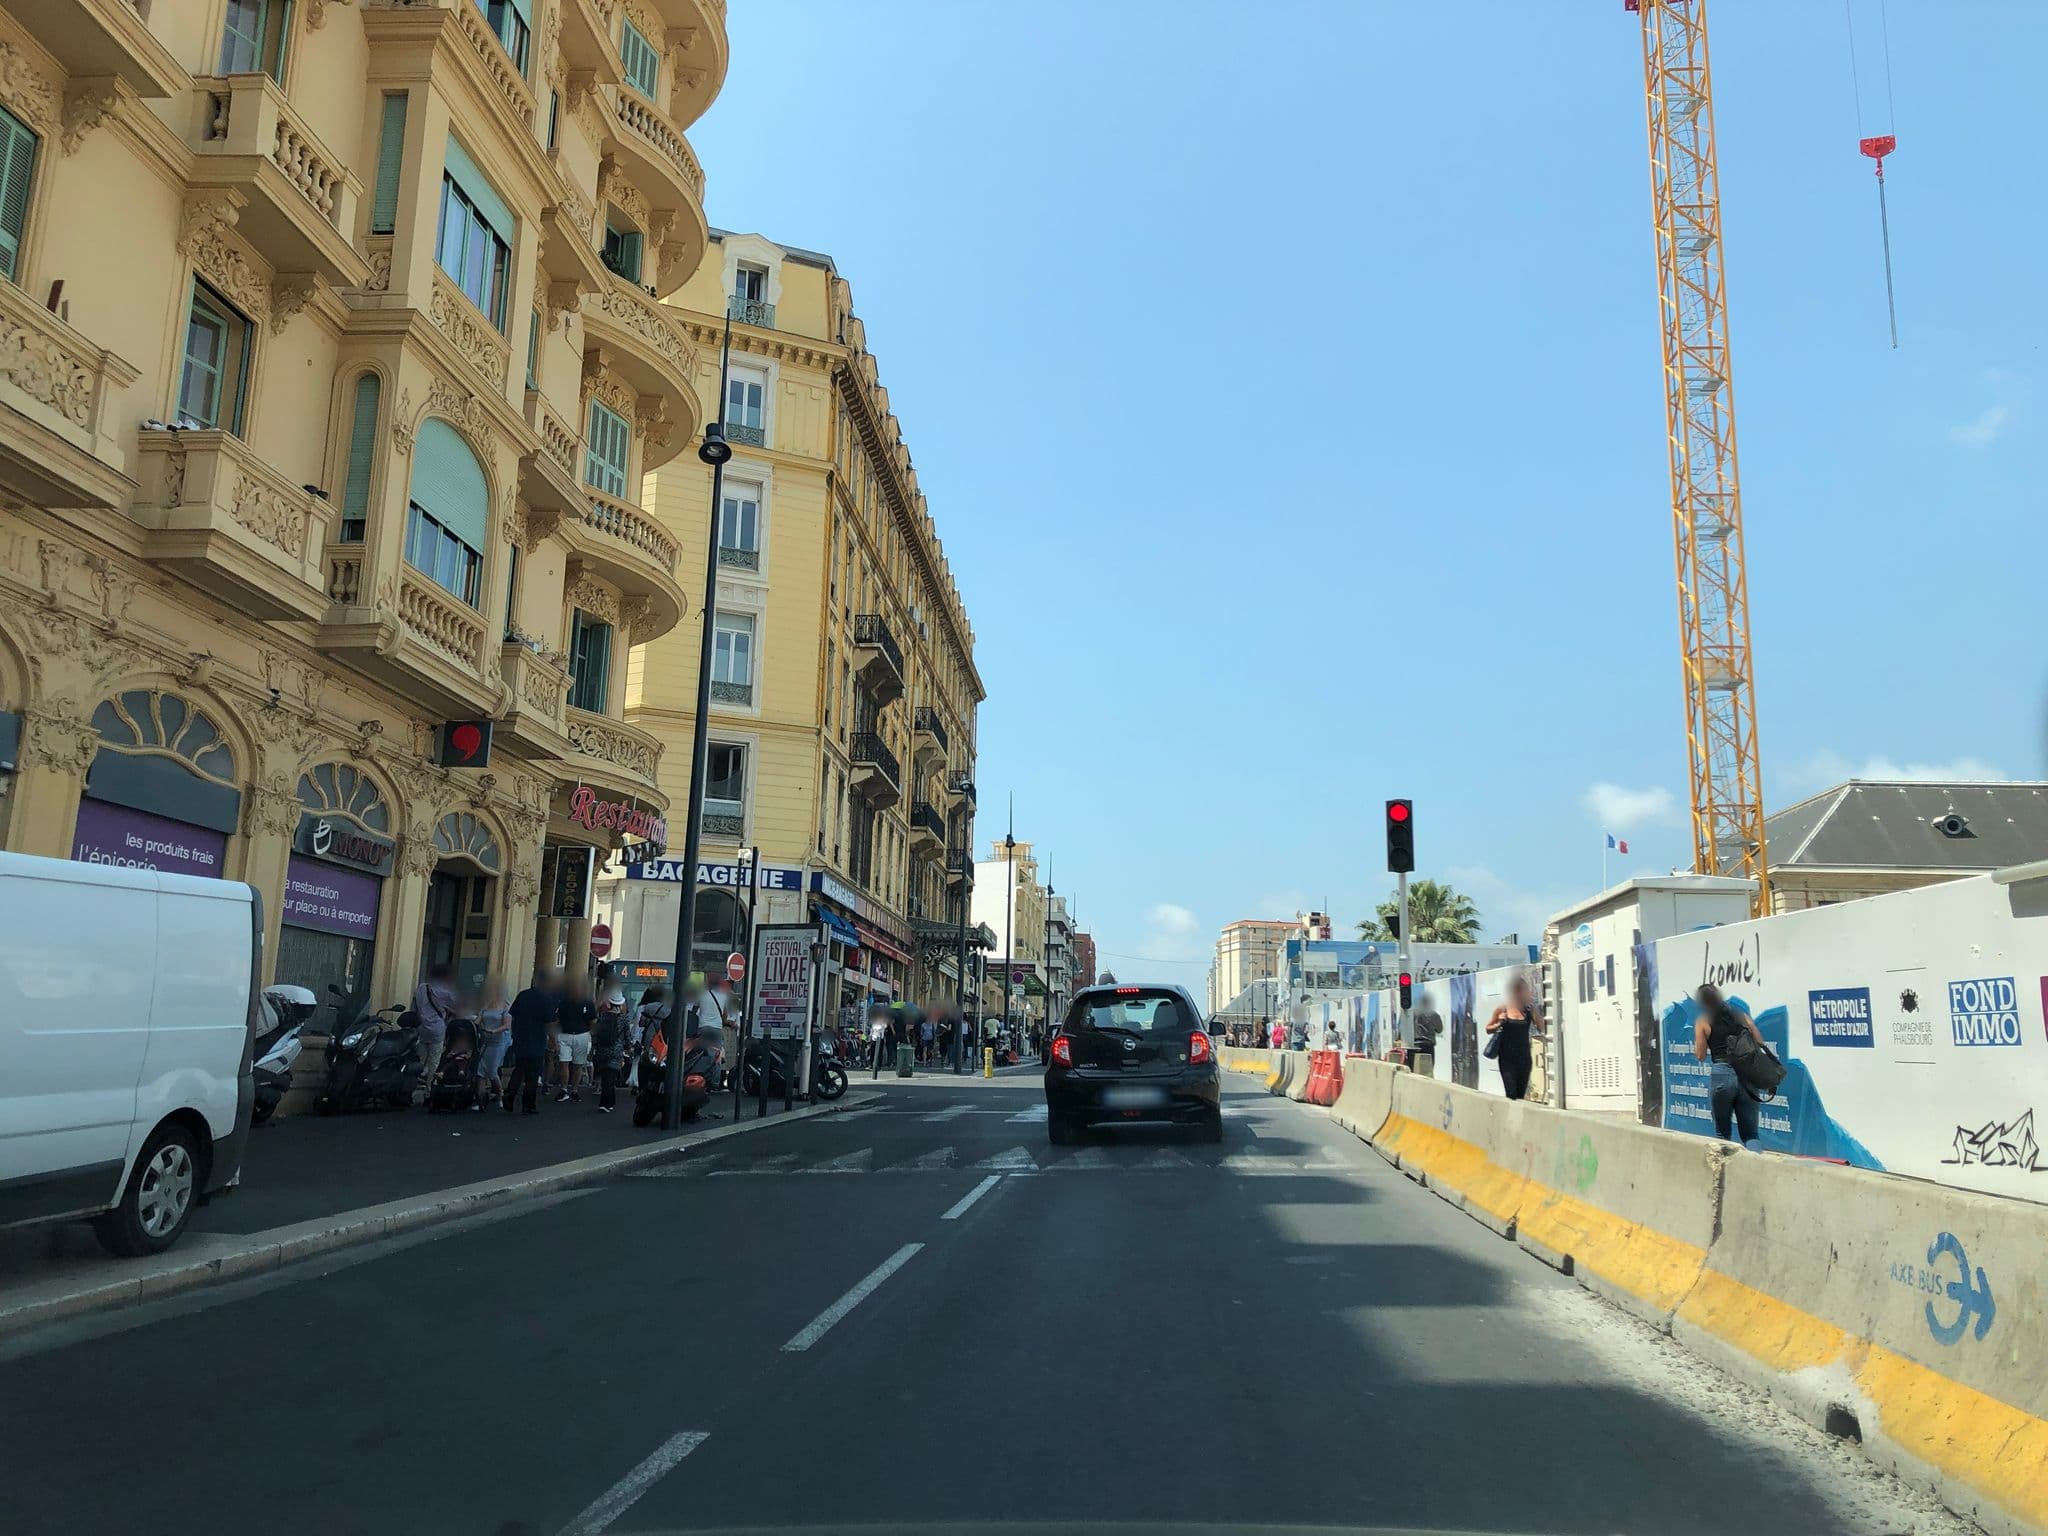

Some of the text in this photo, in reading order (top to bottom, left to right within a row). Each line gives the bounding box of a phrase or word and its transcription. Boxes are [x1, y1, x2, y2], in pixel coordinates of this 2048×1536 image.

[126, 832, 214, 865] les produits frais
[291, 880, 339, 900] restauration
[295, 899, 318, 914] place
[319, 905, 330, 917] ou
[331, 906, 337, 918] à
[338, 909, 372, 925] emporter
[765, 941, 802, 956] FESTIVAL
[621, 965, 629, 978] 4
[765, 956, 808, 983] LIVRE
[788, 983, 808, 998] NICE
[1951, 980, 2015, 1012] FOND
[1812, 995, 1868, 1019] MÉTROPOLE
[1815, 1020, 1870, 1036] NICE CÔTE D'AZUR
[1953, 1014, 2019, 1046] IMMO
[1890, 1263, 1943, 1296] AXE BUS
